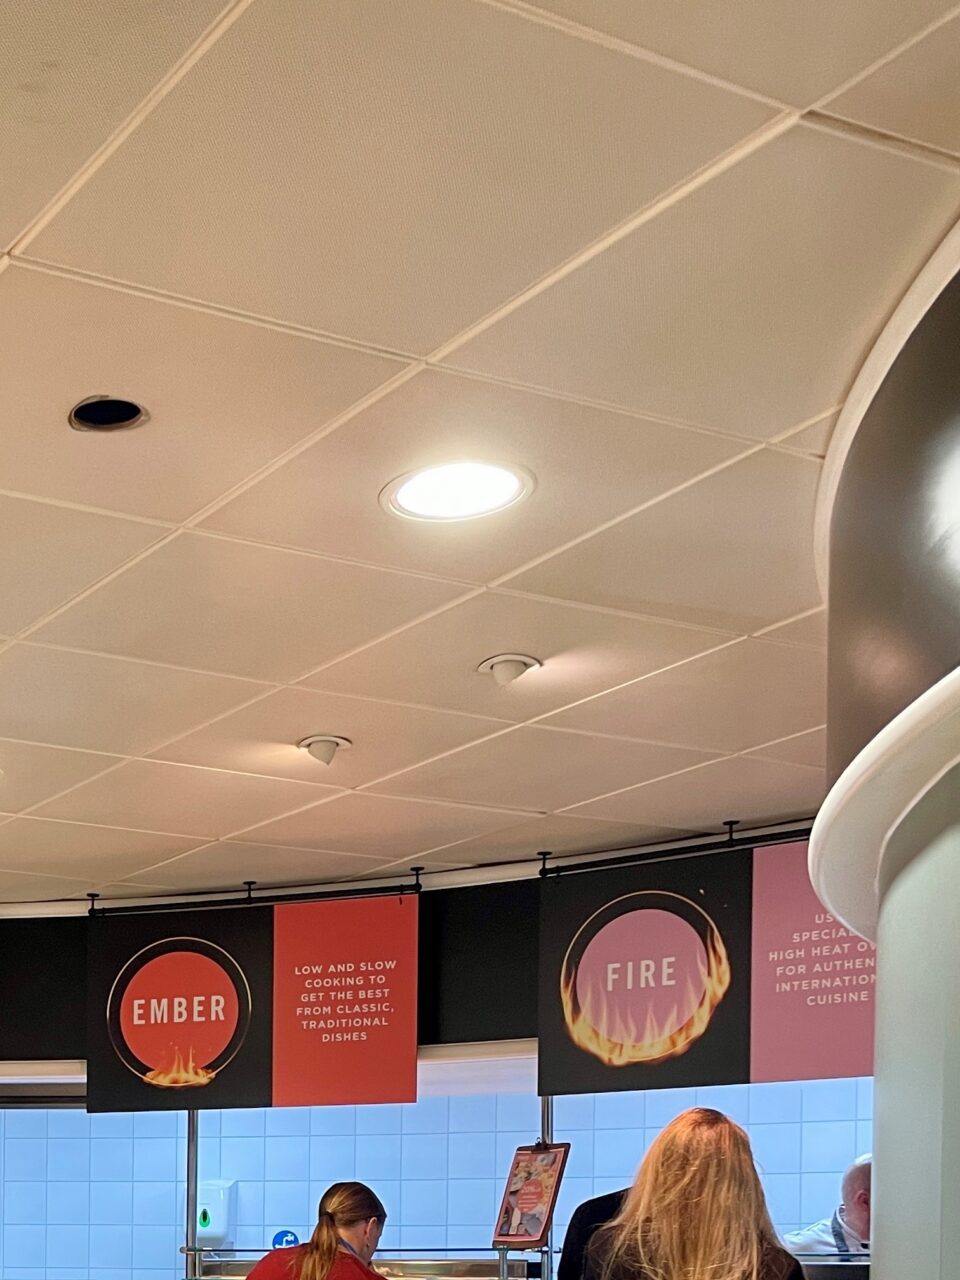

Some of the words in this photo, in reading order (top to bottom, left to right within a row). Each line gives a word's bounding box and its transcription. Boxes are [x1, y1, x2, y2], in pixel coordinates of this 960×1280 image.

[814, 913, 834, 924] US
[792, 928, 856, 943] SPECIAL
[768, 948, 805, 962] HIGH
[811, 943, 852, 957] HEAT
[857, 941, 877, 953] OV
[294, 964, 323, 975] LOW
[327, 963, 355, 973] AND
[359, 960, 397, 971] SLOW
[606, 956, 677, 992] FIRE
[776, 964, 807, 977] FOR
[812, 958, 876, 973] AUTHEN
[304, 976, 364, 989] COOKING
[368, 974, 386, 985] TO
[775, 974, 877, 993] INTERNATION
[300, 992, 325, 1002] GET
[329, 990, 354, 1001] THE
[358, 988, 390, 999] BEST
[806, 990, 869, 1006] CUISINE
[133, 995, 225, 1025] EMBER
[296, 1005, 332, 1017] FROM
[336, 1002, 394, 1014] CLASSIC,
[301, 1016, 389, 1030] TRADITIONAL
[321, 1031, 367, 1043] DISHES
